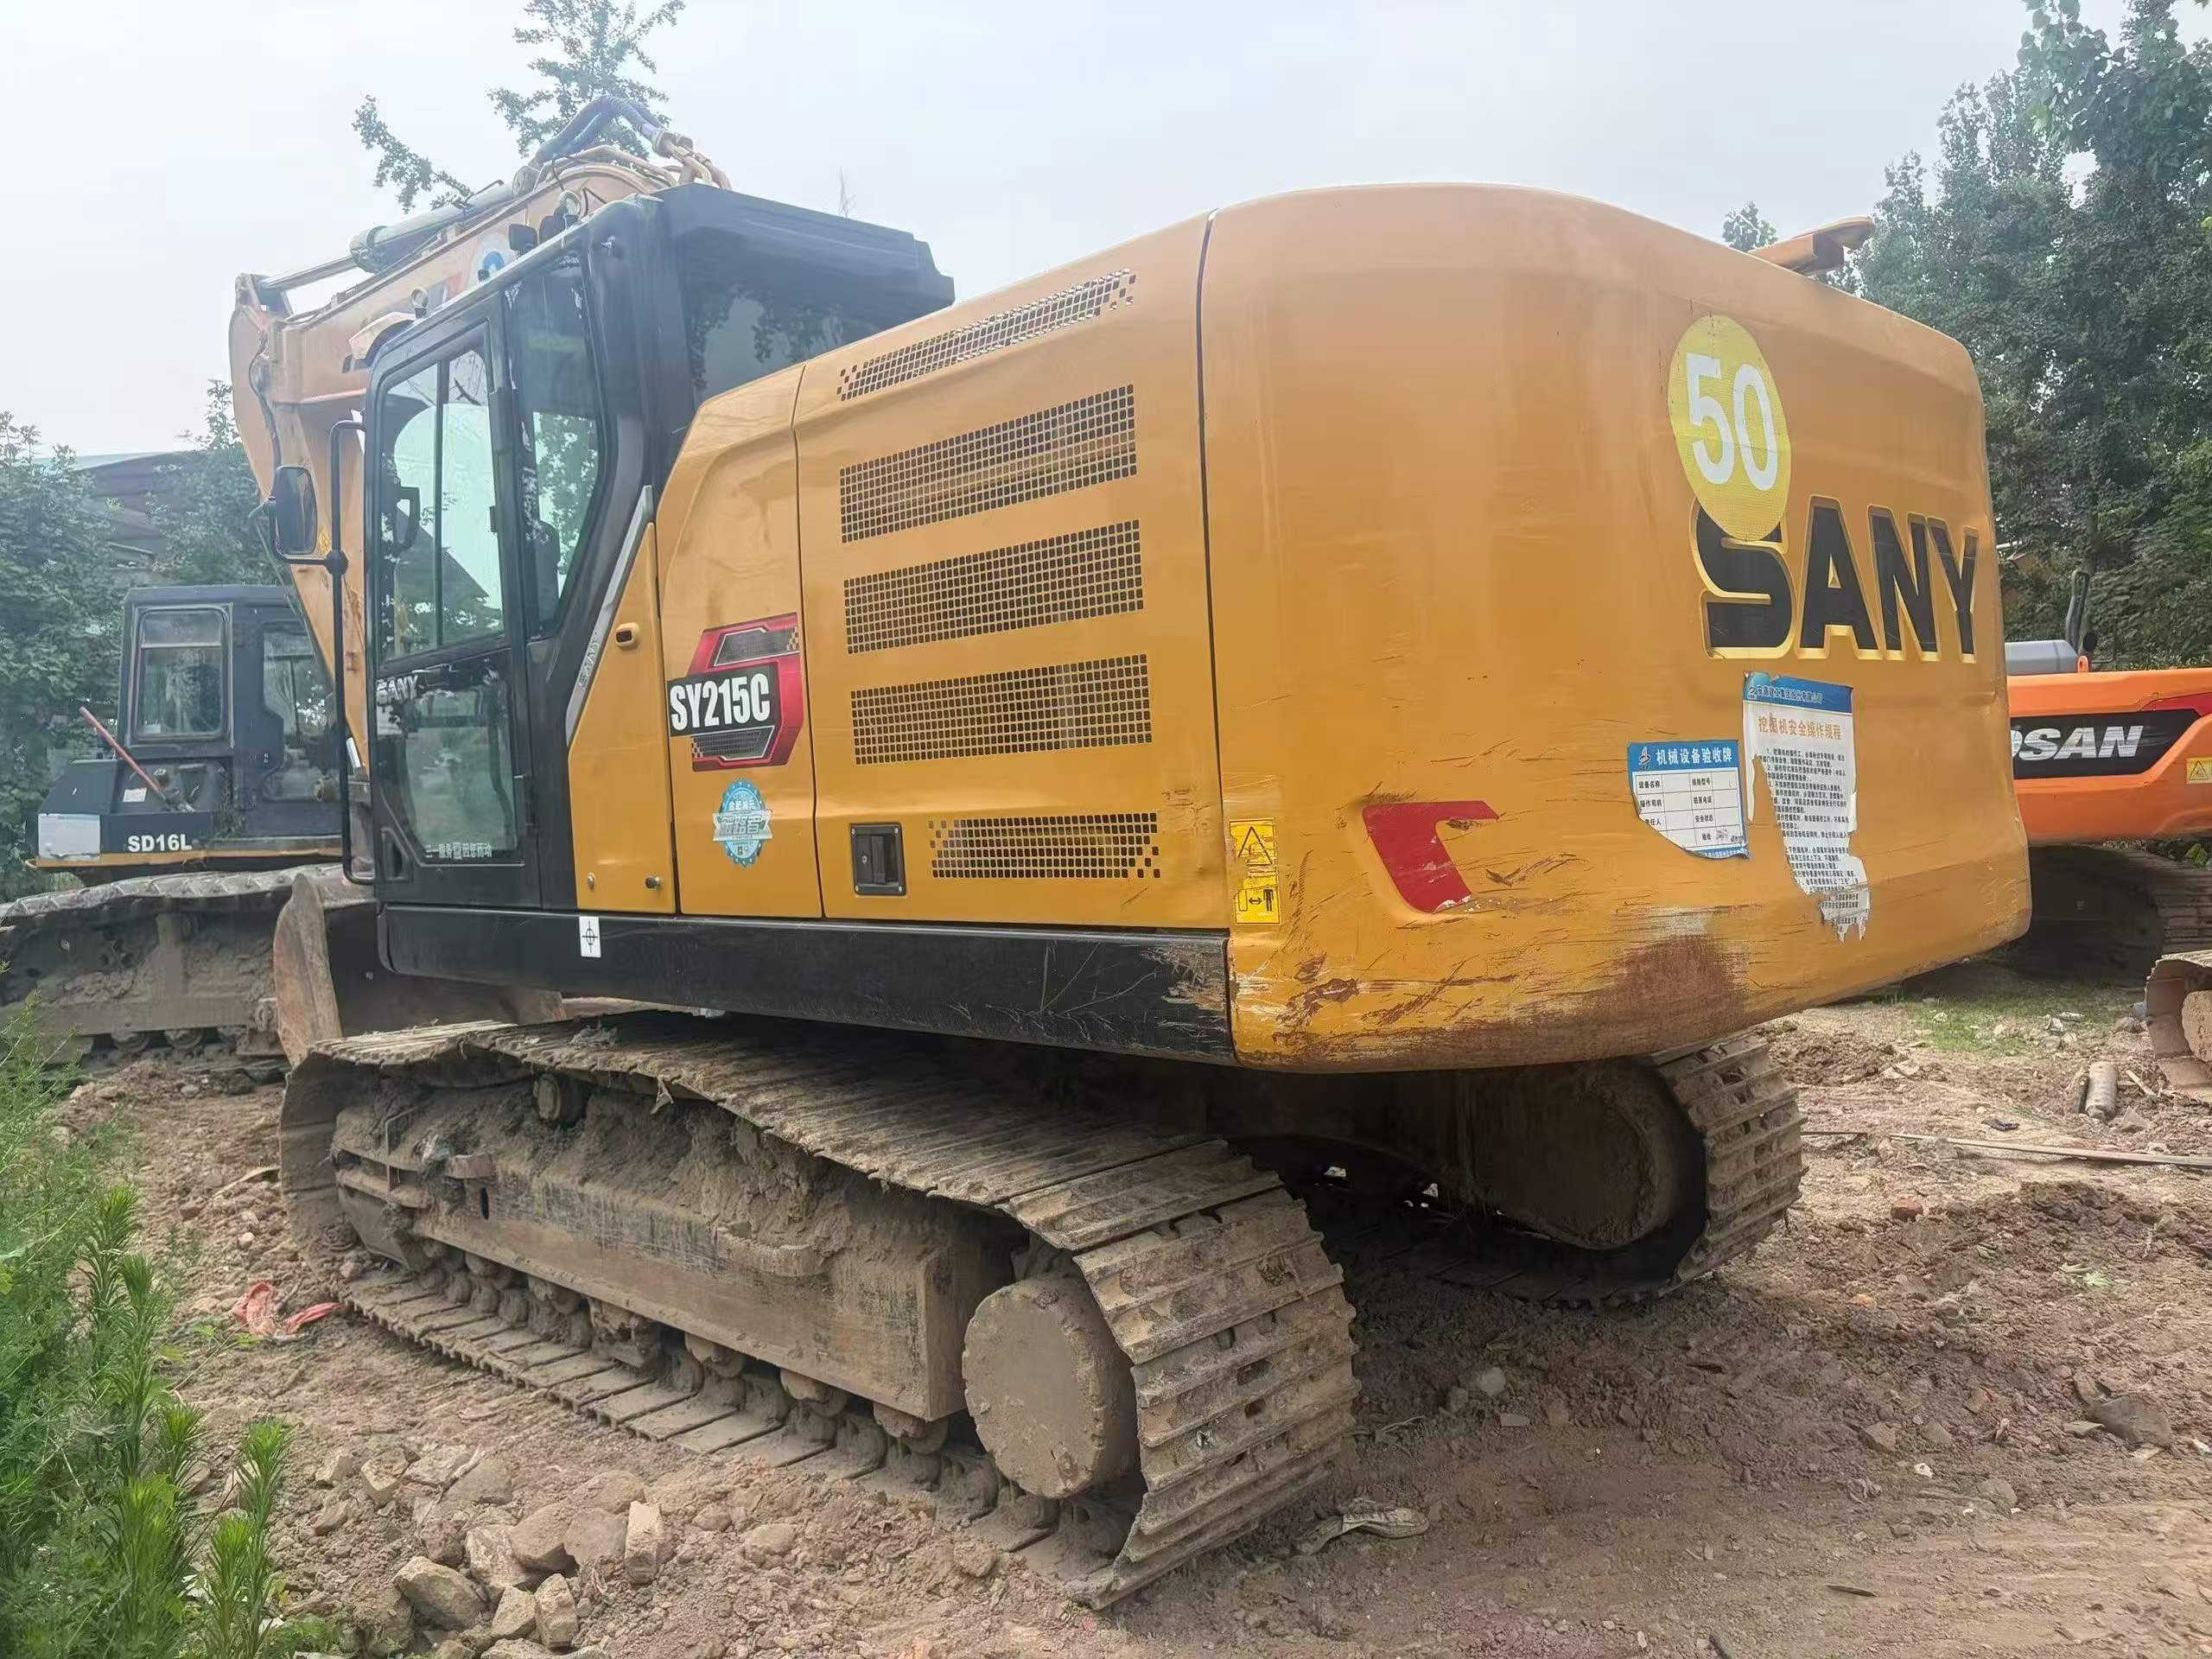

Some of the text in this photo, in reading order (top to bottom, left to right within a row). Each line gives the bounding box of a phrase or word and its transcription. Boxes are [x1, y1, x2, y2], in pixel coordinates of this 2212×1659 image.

[1686, 353, 1778, 491] 50
[1690, 496, 1979, 662] SANY
[670, 673, 771, 731] SY215C
[1758, 714, 1842, 741] 挖掘机安全操作规程
[2011, 725, 2143, 761] SAN
[1656, 747, 1732, 766] 机械设备验收牌
[1638, 779, 1661, 789] 设备名称
[1639, 799, 1662, 809] 操作司机
[1694, 815, 1713, 823] 安全状态
[127, 834, 193, 853] SD16L
